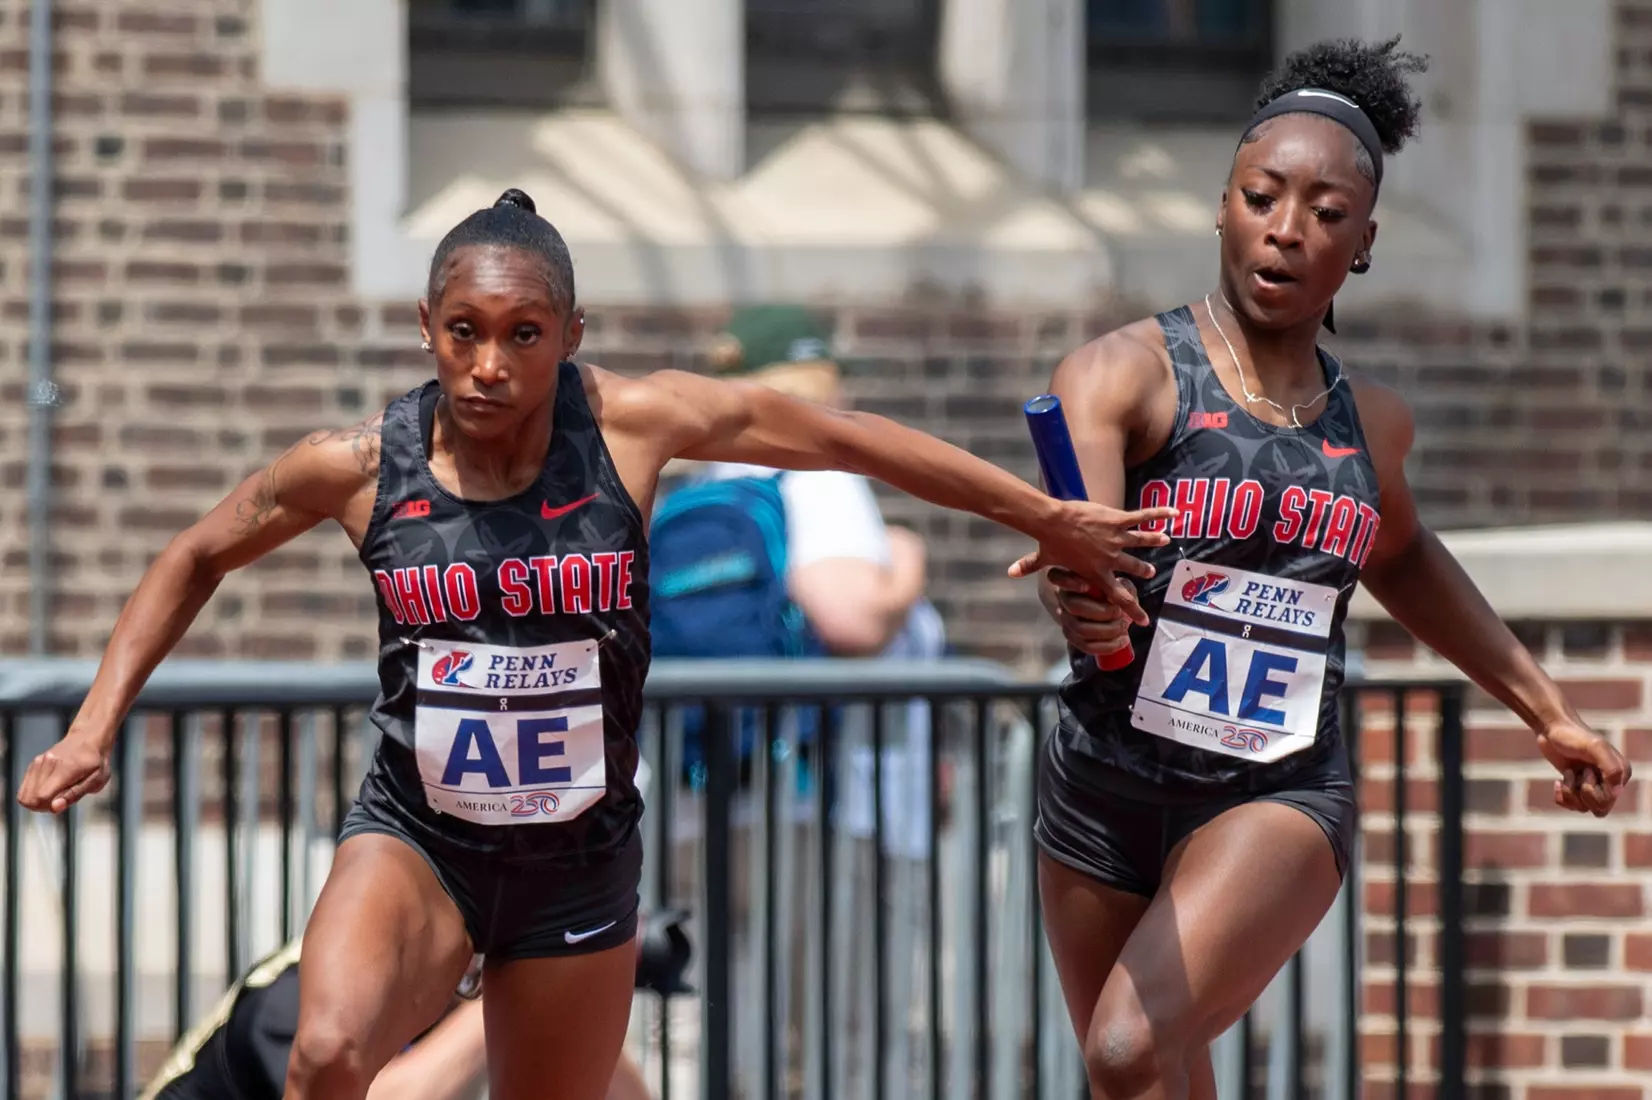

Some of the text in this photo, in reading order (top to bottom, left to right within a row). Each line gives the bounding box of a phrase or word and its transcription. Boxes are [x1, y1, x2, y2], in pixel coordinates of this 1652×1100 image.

[1138, 478, 1264, 540] OHIO
[497, 550, 635, 617] STATE
[1242, 581, 1304, 606] PENN
[1233, 598, 1316, 627] RELAYS
[484, 667, 578, 689] RELAYS
[488, 653, 558, 671] PENN
[1161, 637, 1299, 726] AE
[1168, 718, 1269, 753] AMERICA 250
[440, 716, 572, 788] AE
[455, 792, 560, 817] AMERICA 250
